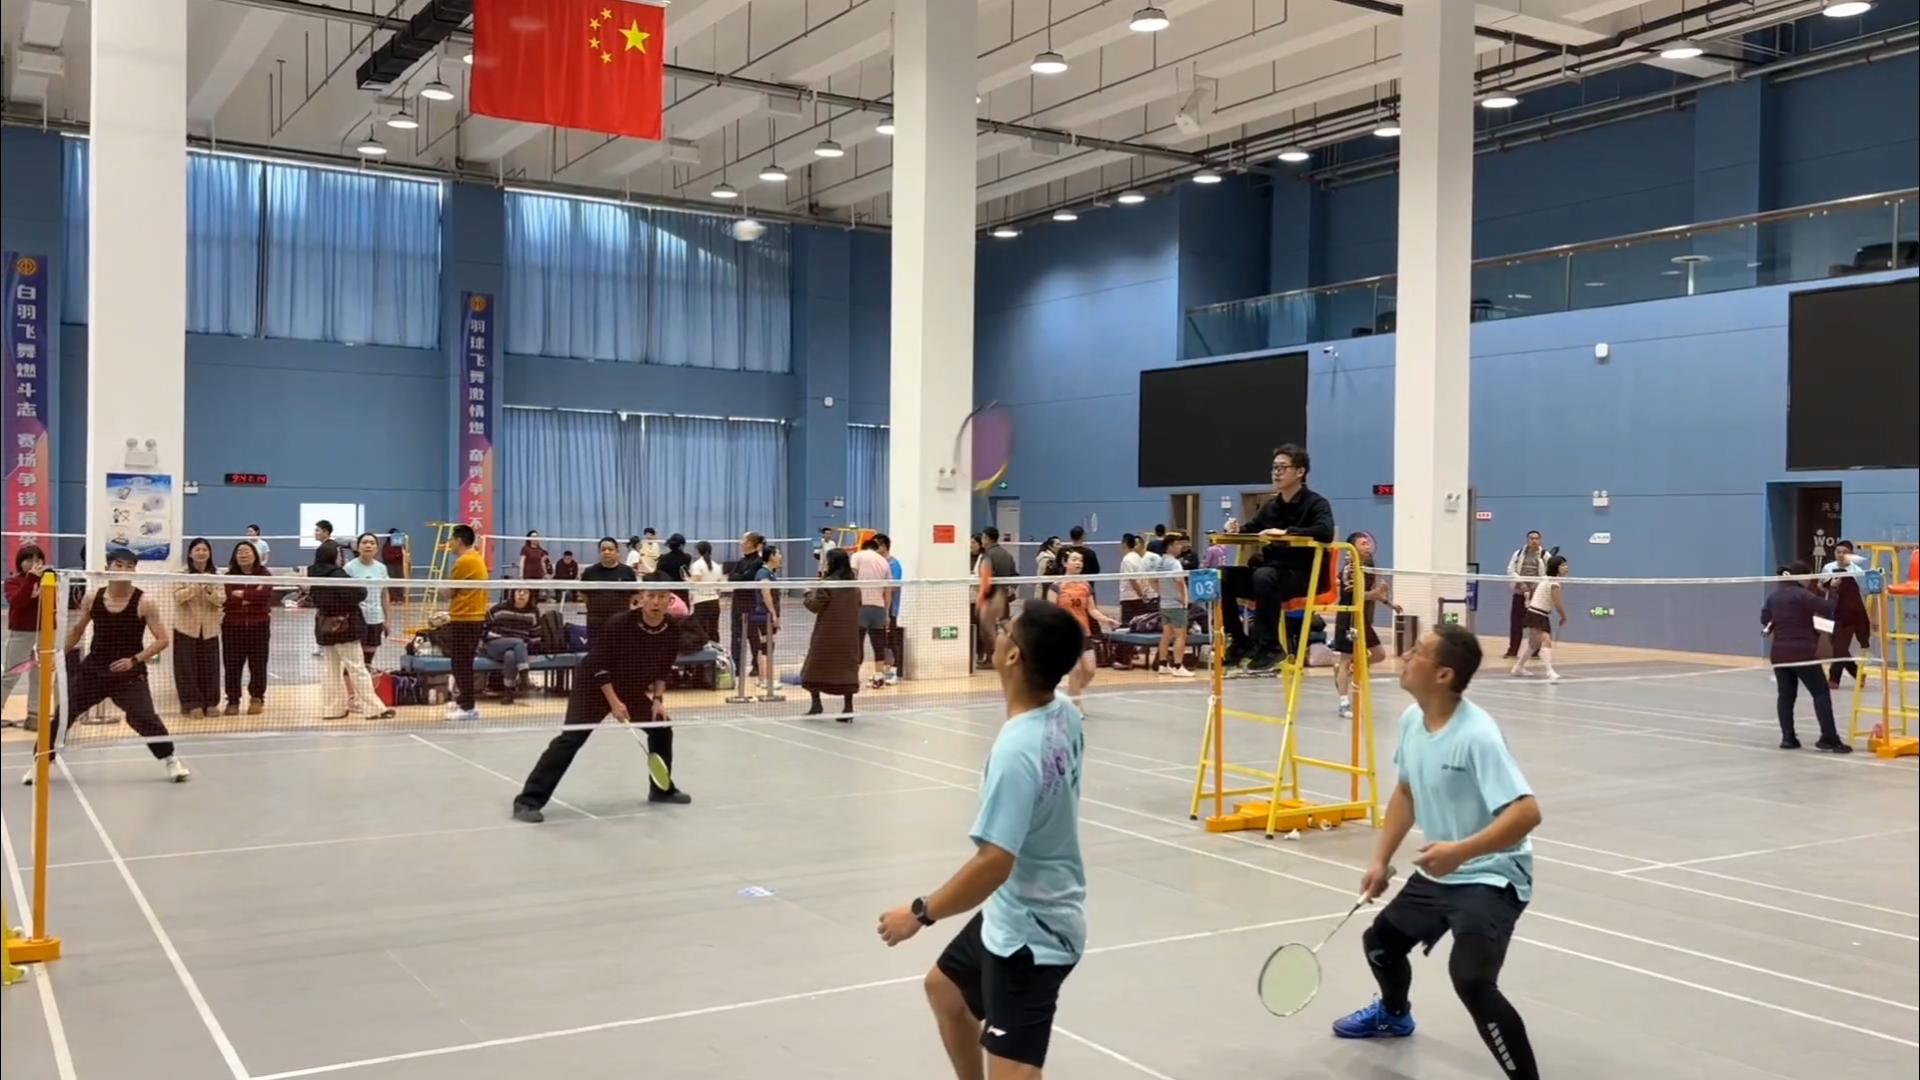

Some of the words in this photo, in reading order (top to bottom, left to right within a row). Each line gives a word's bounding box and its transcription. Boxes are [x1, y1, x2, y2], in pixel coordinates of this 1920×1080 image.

[16, 284, 37, 417] 白羽飞舞燃斗志
[469, 319, 485, 434] 羽球飞舞激情燃
[1813, 536, 1841, 547] WO
[1195, 581, 1215, 596] 03
[1868, 579, 1880, 590] 02
